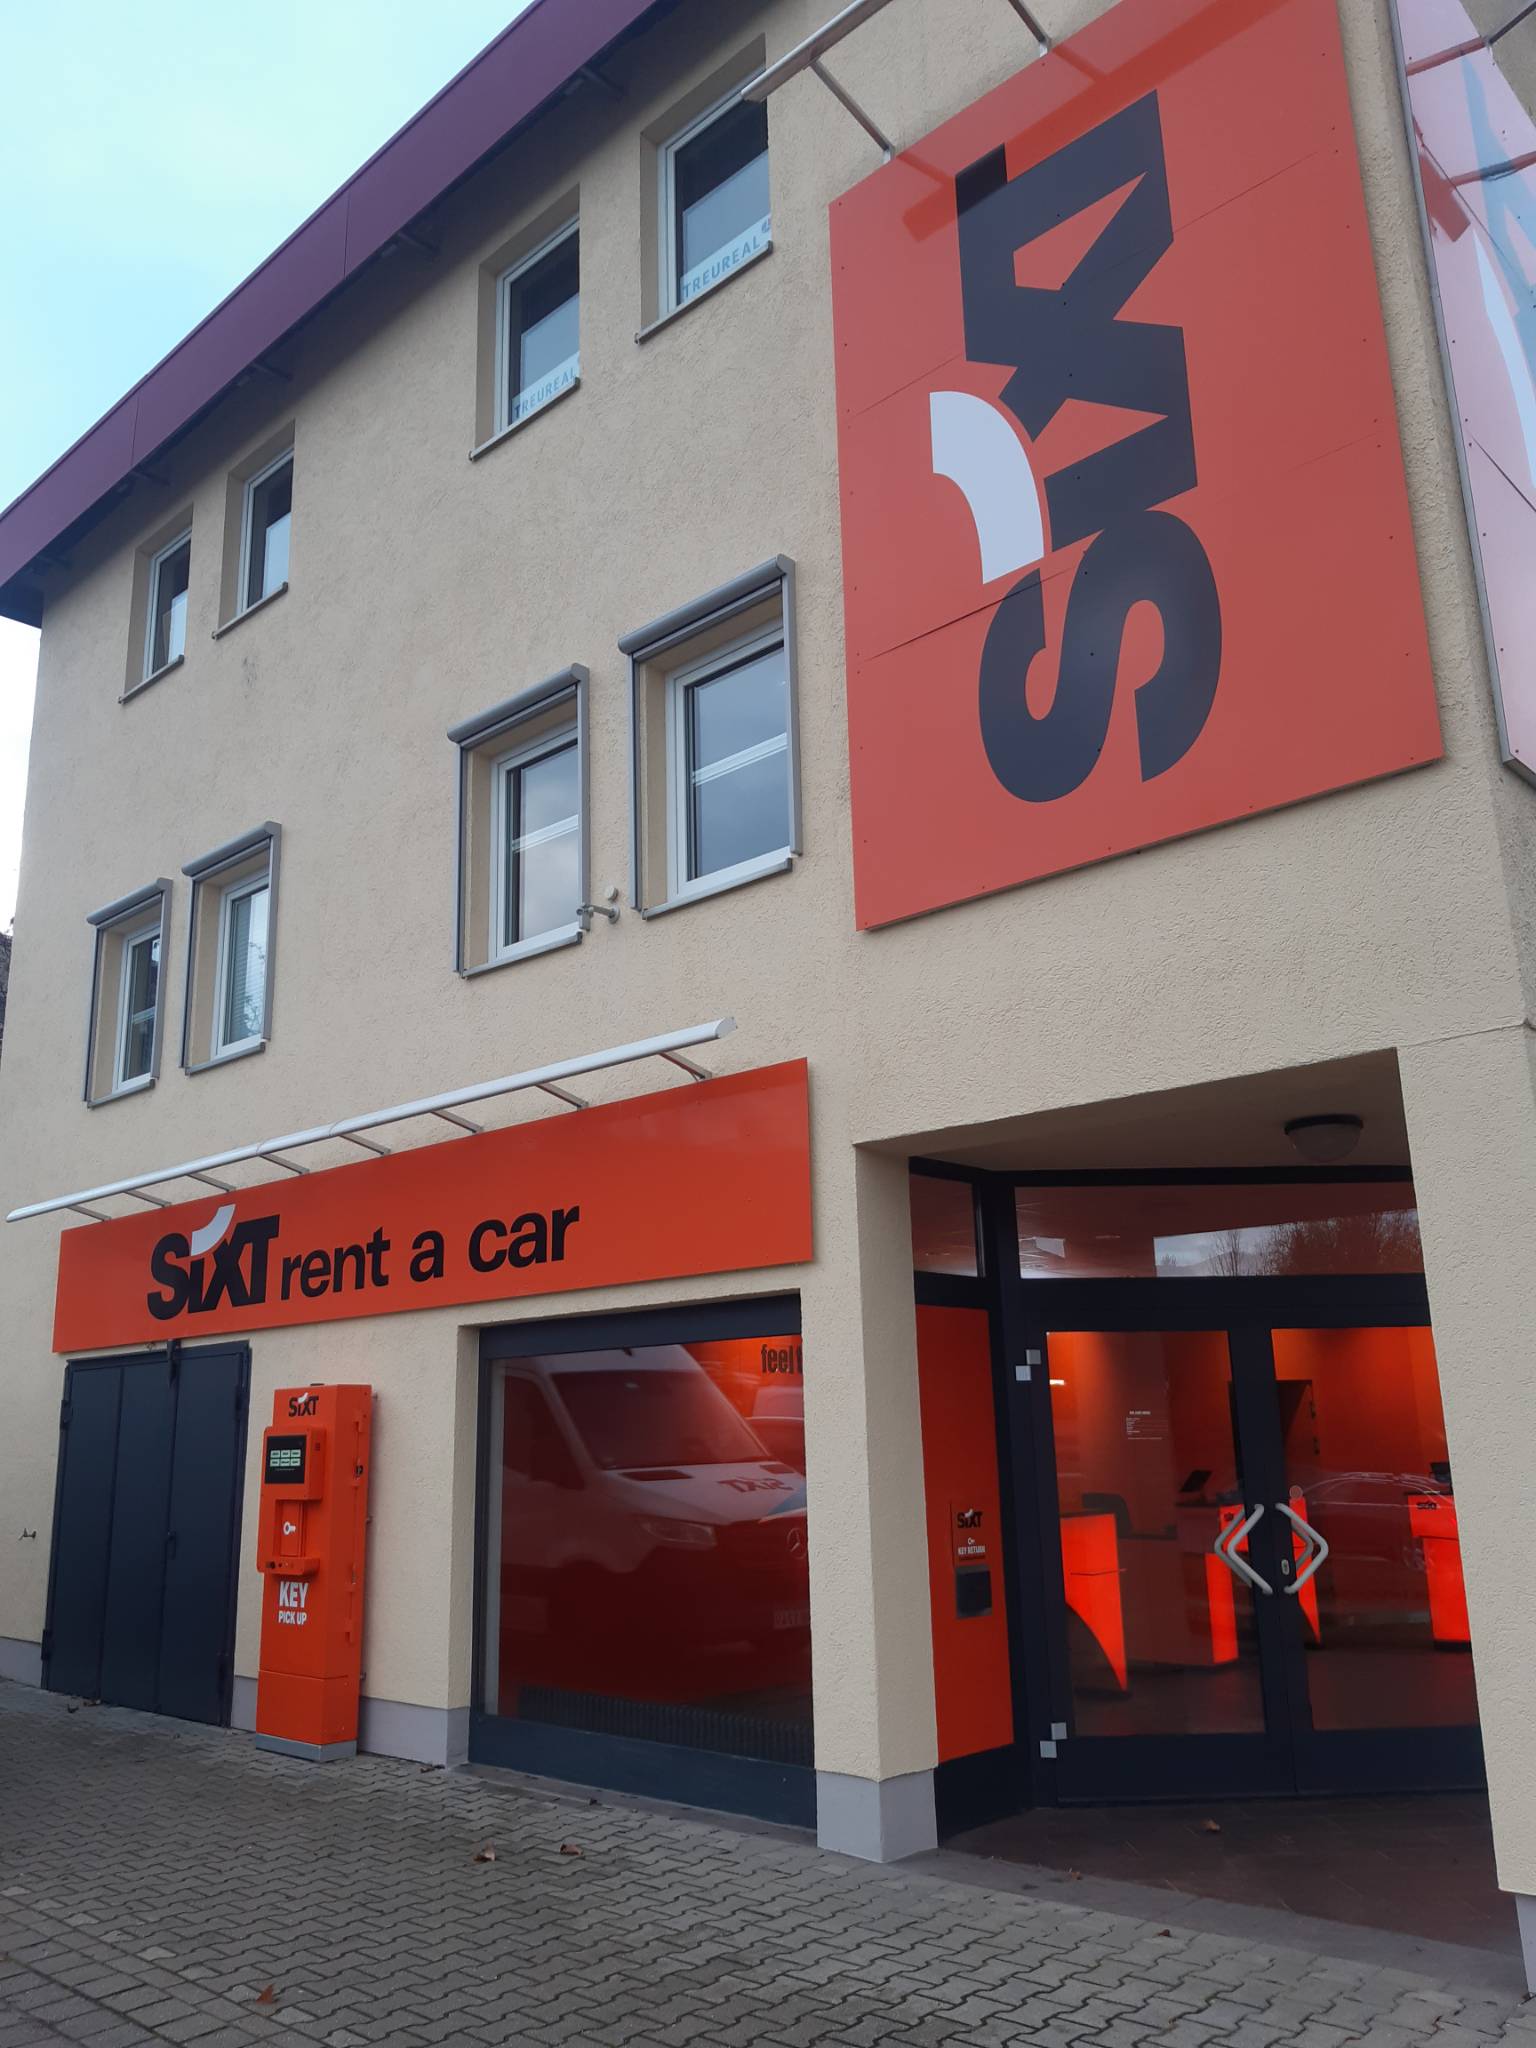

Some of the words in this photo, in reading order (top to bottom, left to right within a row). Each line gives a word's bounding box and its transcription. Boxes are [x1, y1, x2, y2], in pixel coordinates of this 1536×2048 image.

[682, 236, 760, 299] TREUREAL
[514, 367, 577, 419] TREUREAL
[281, 1226, 391, 1301] rent
[409, 1230, 445, 1283] a
[468, 1205, 580, 1273] car
[760, 1343, 794, 1374] feel
[279, 1581, 309, 1608] KEY
[278, 1610, 296, 1624] PICK
[296, 1612, 307, 1625] UP
